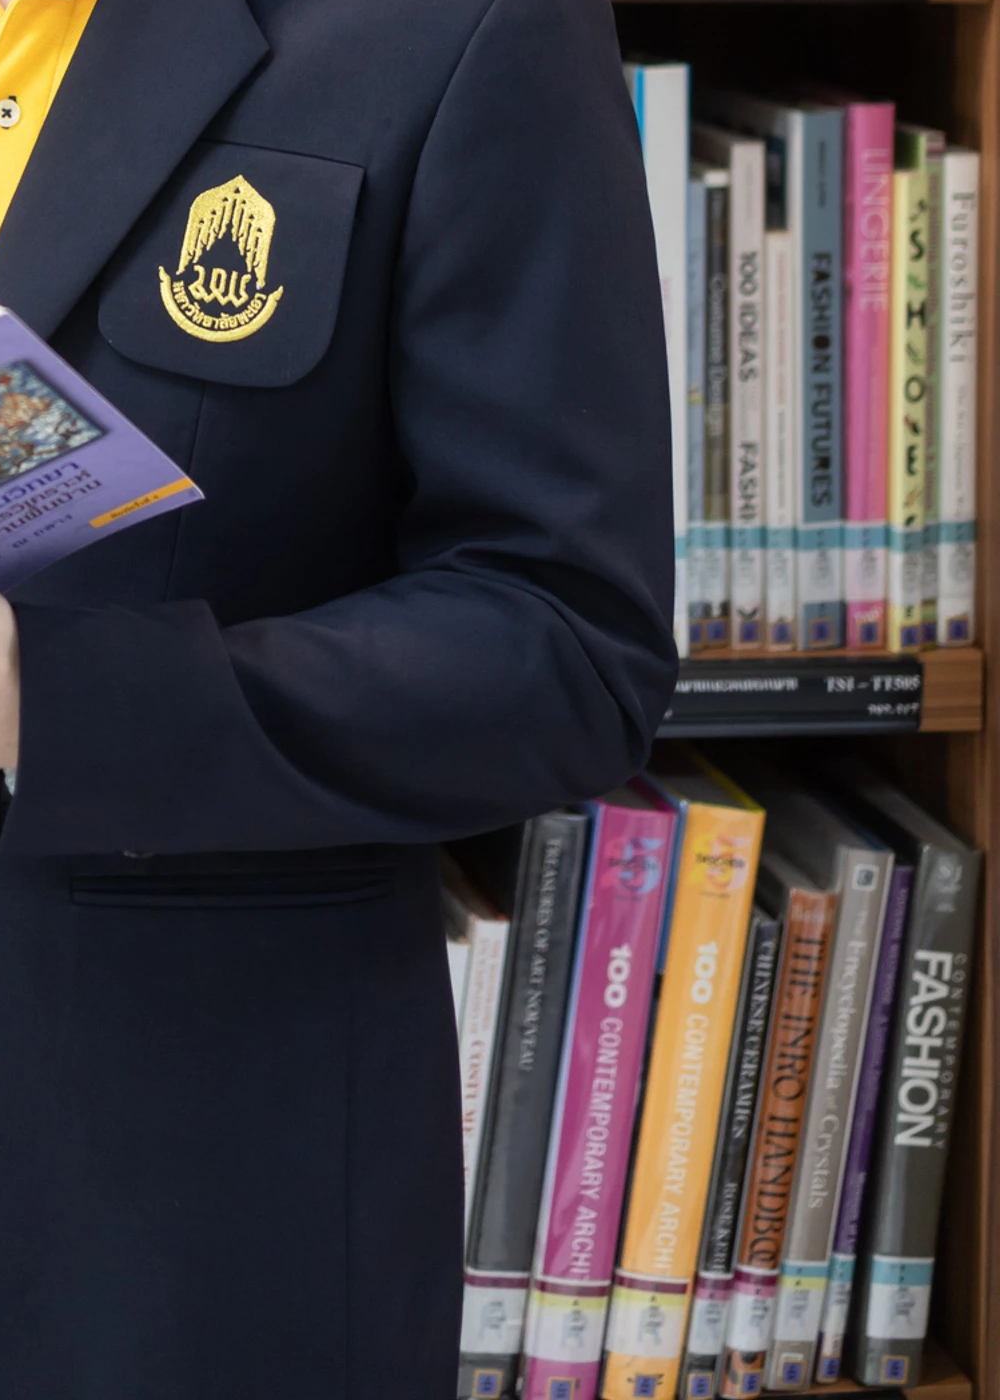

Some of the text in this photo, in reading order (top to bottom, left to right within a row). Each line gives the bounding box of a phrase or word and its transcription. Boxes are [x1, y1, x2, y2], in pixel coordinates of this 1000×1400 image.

[172, 279, 267, 330] มหาวิทยาลัยพะเยา
[860, 149, 888, 312] LINGERIE
[948, 190, 974, 366] Furoshiki
[706, 274, 726, 438] Costume Design
[739, 250, 758, 382] 100 IDEAS
[810, 252, 832, 509] FASHION FUTURES
[739, 442, 758, 522] FASHI
[519, 837, 561, 1073] TREASURES OF ART NOUVEAU
[790, 931, 828, 1000] THE
[823, 939, 866, 1091] Encyclopedia
[569, 944, 632, 1281] 100 CONTEMPORARY ARCHI
[651, 940, 718, 1278] 100 CONTEMPORARY ARCHI
[731, 940, 776, 1140] CHINESE CERAMICS
[771, 1011, 815, 1105] INRO
[893, 951, 953, 1147] FASHION
[719, 1182, 738, 1223] ROSE
[806, 1114, 839, 1210] Crystals
